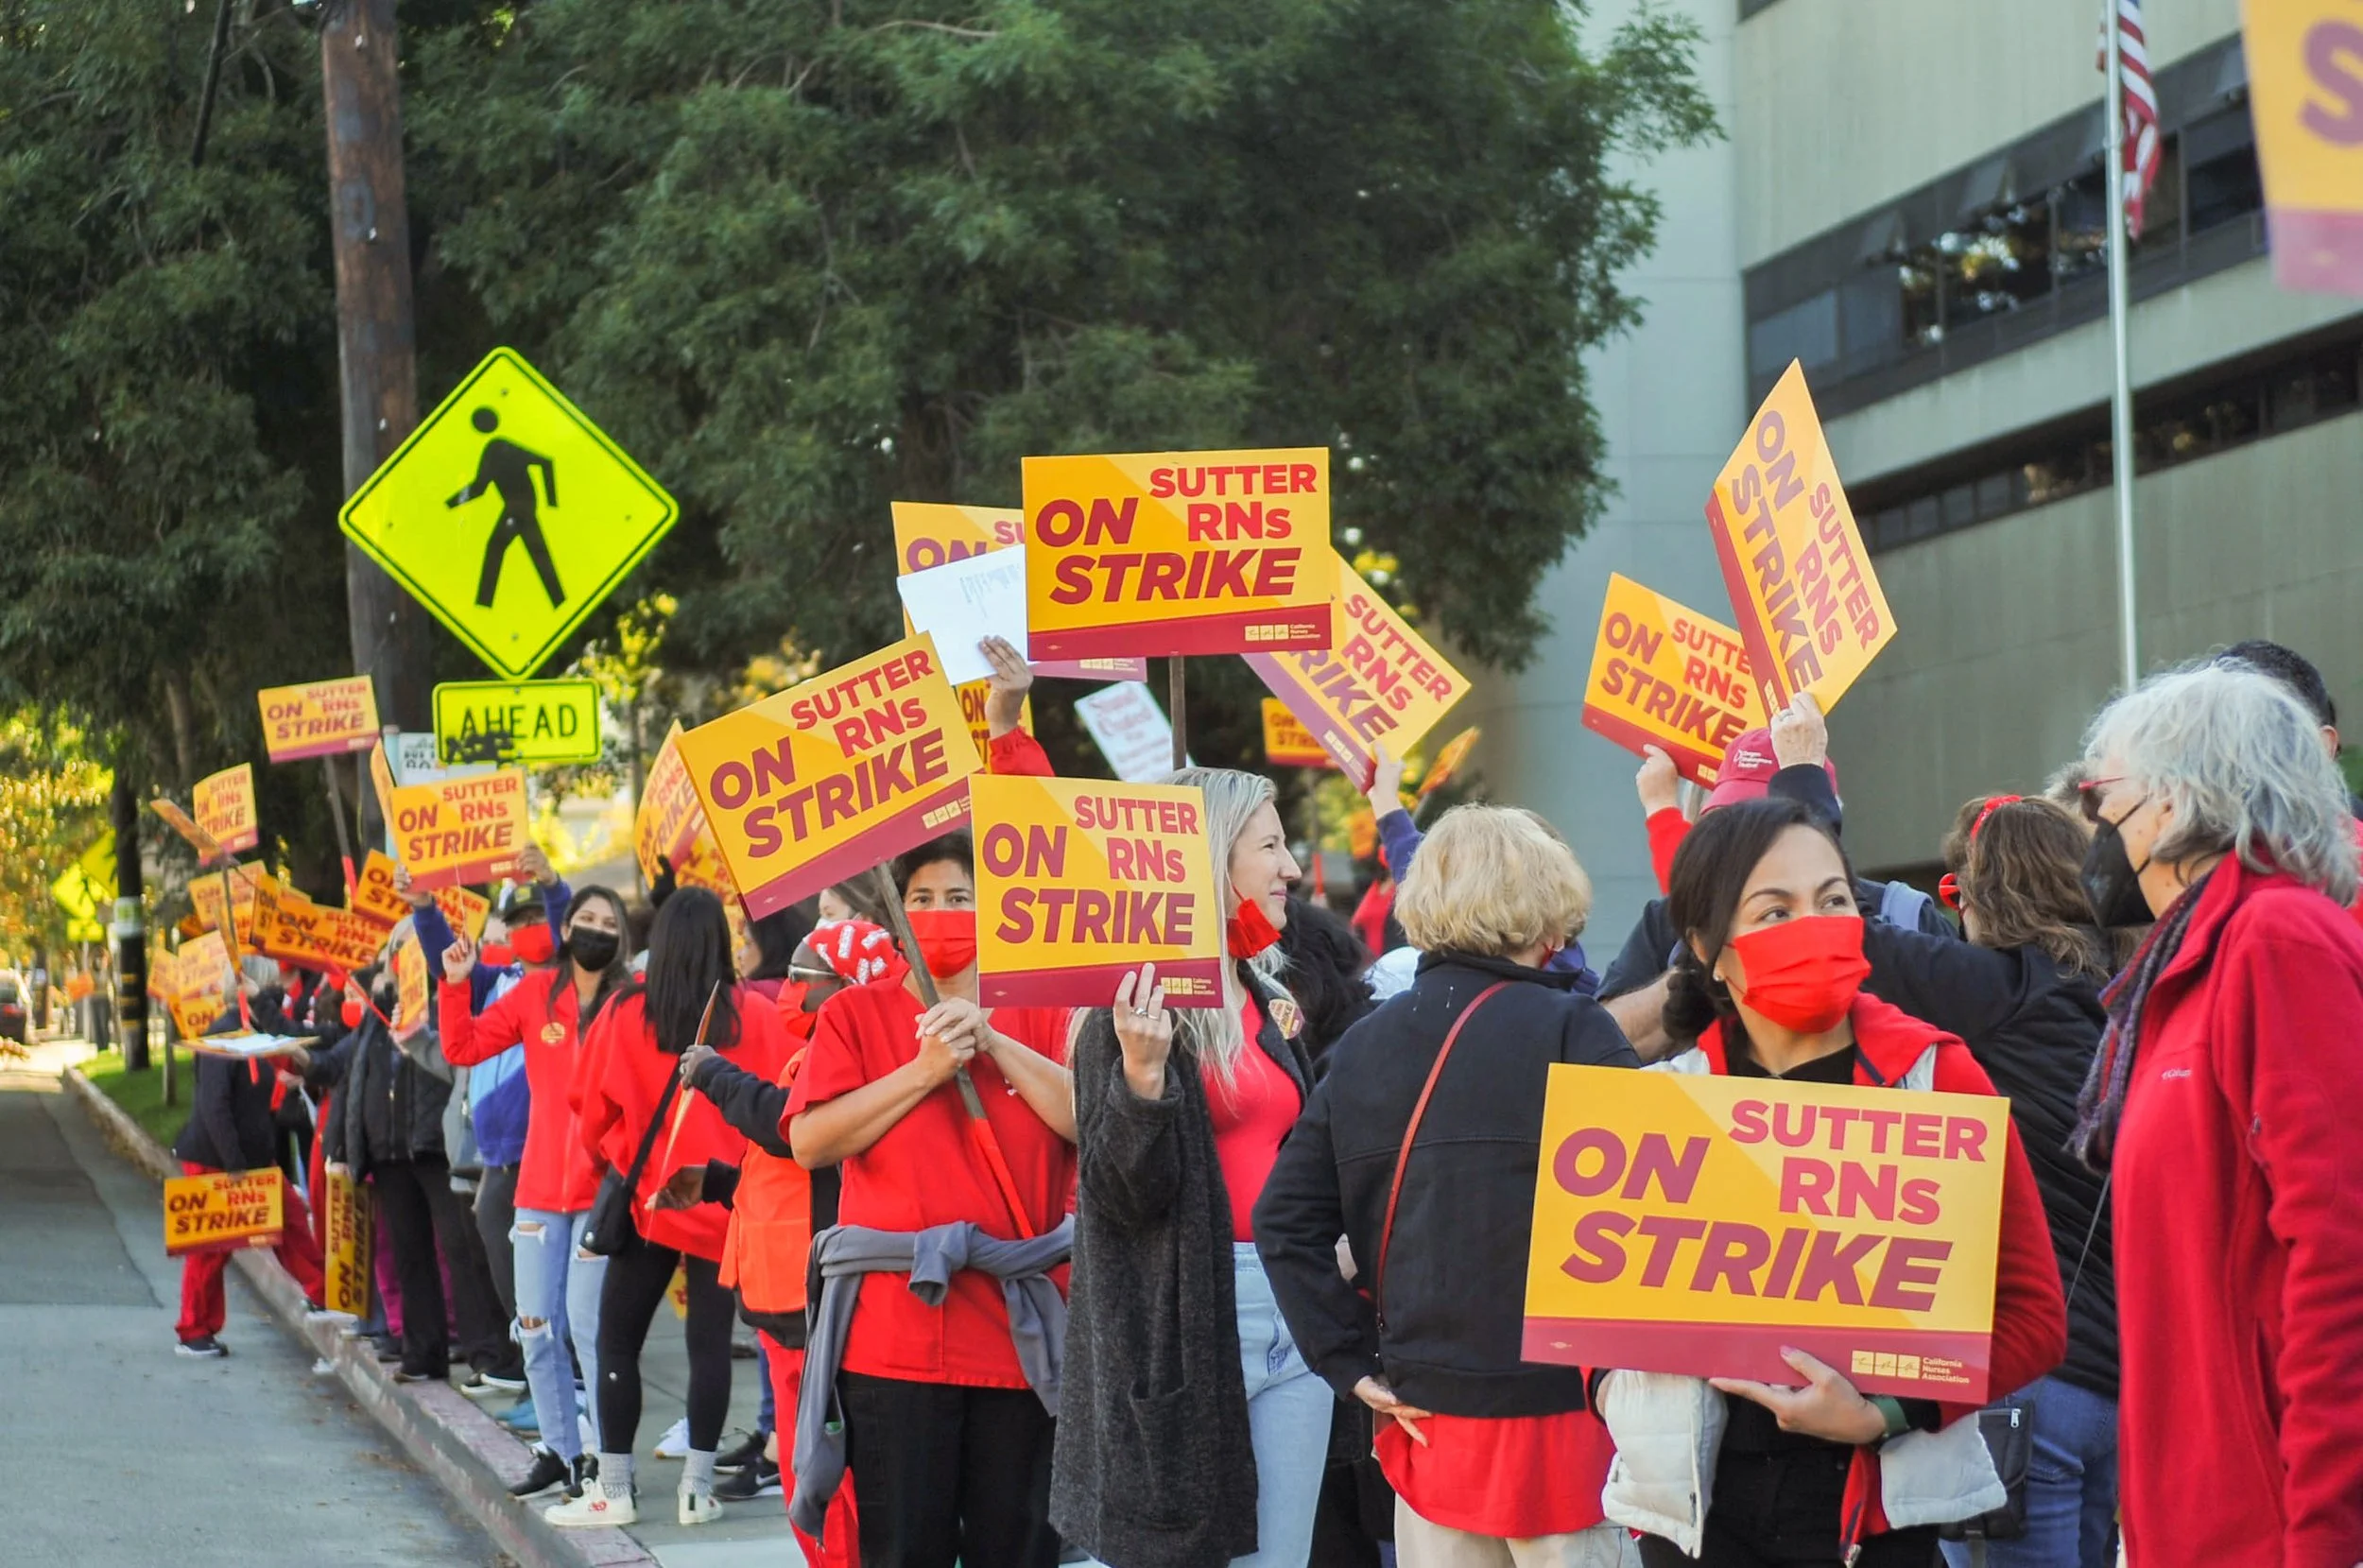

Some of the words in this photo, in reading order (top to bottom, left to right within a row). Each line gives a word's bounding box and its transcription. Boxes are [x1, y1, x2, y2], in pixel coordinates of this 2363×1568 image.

[1149, 463, 1318, 498] SUTTER
[1756, 410, 1805, 512] ON
[1035, 497, 1139, 547] ON
[1187, 502, 1291, 542] RNs
[1049, 547, 1302, 605] STRIKE
[1733, 464, 1822, 687] STRIKE
[1809, 482, 1879, 649] SUTTER
[1343, 594, 1453, 703] SUTTER
[1605, 612, 1664, 663] ON
[1672, 618, 1755, 677] SUTTE
[790, 649, 936, 731] SUTTER
[1286, 649, 1399, 744] RIKE
[1341, 634, 1413, 712] RNs
[1683, 660, 1747, 710] RNs
[267, 701, 302, 719] ON
[276, 713, 365, 739] STRIKE
[459, 704, 578, 740] AHEAD
[833, 698, 928, 758] RNs
[962, 688, 986, 723] ON
[1600, 660, 1747, 749] STRIKE
[442, 777, 518, 801] SUTTER
[710, 735, 797, 810] ON
[743, 727, 949, 858] STRIKE
[398, 804, 438, 833] ON
[460, 800, 509, 822] RNs
[1074, 795, 1199, 835] SUTTER
[408, 820, 514, 861] STRIKE
[981, 822, 1067, 878] ON
[1106, 837, 1186, 883] RNs
[995, 887, 1196, 945] STRIKE
[1728, 1099, 1988, 1163] SUTTER
[1552, 1128, 1711, 1203] ON
[1779, 1156, 1940, 1225] RNs
[168, 1192, 207, 1212] ON
[174, 1206, 270, 1235] STRIKE
[338, 1261, 352, 1309] ON
[1560, 1210, 1954, 1312] STRIKE
[1922, 1372, 1970, 1384] Association
[1923, 1357, 1963, 1369] California
[1923, 1365, 1951, 1374] Nurses
